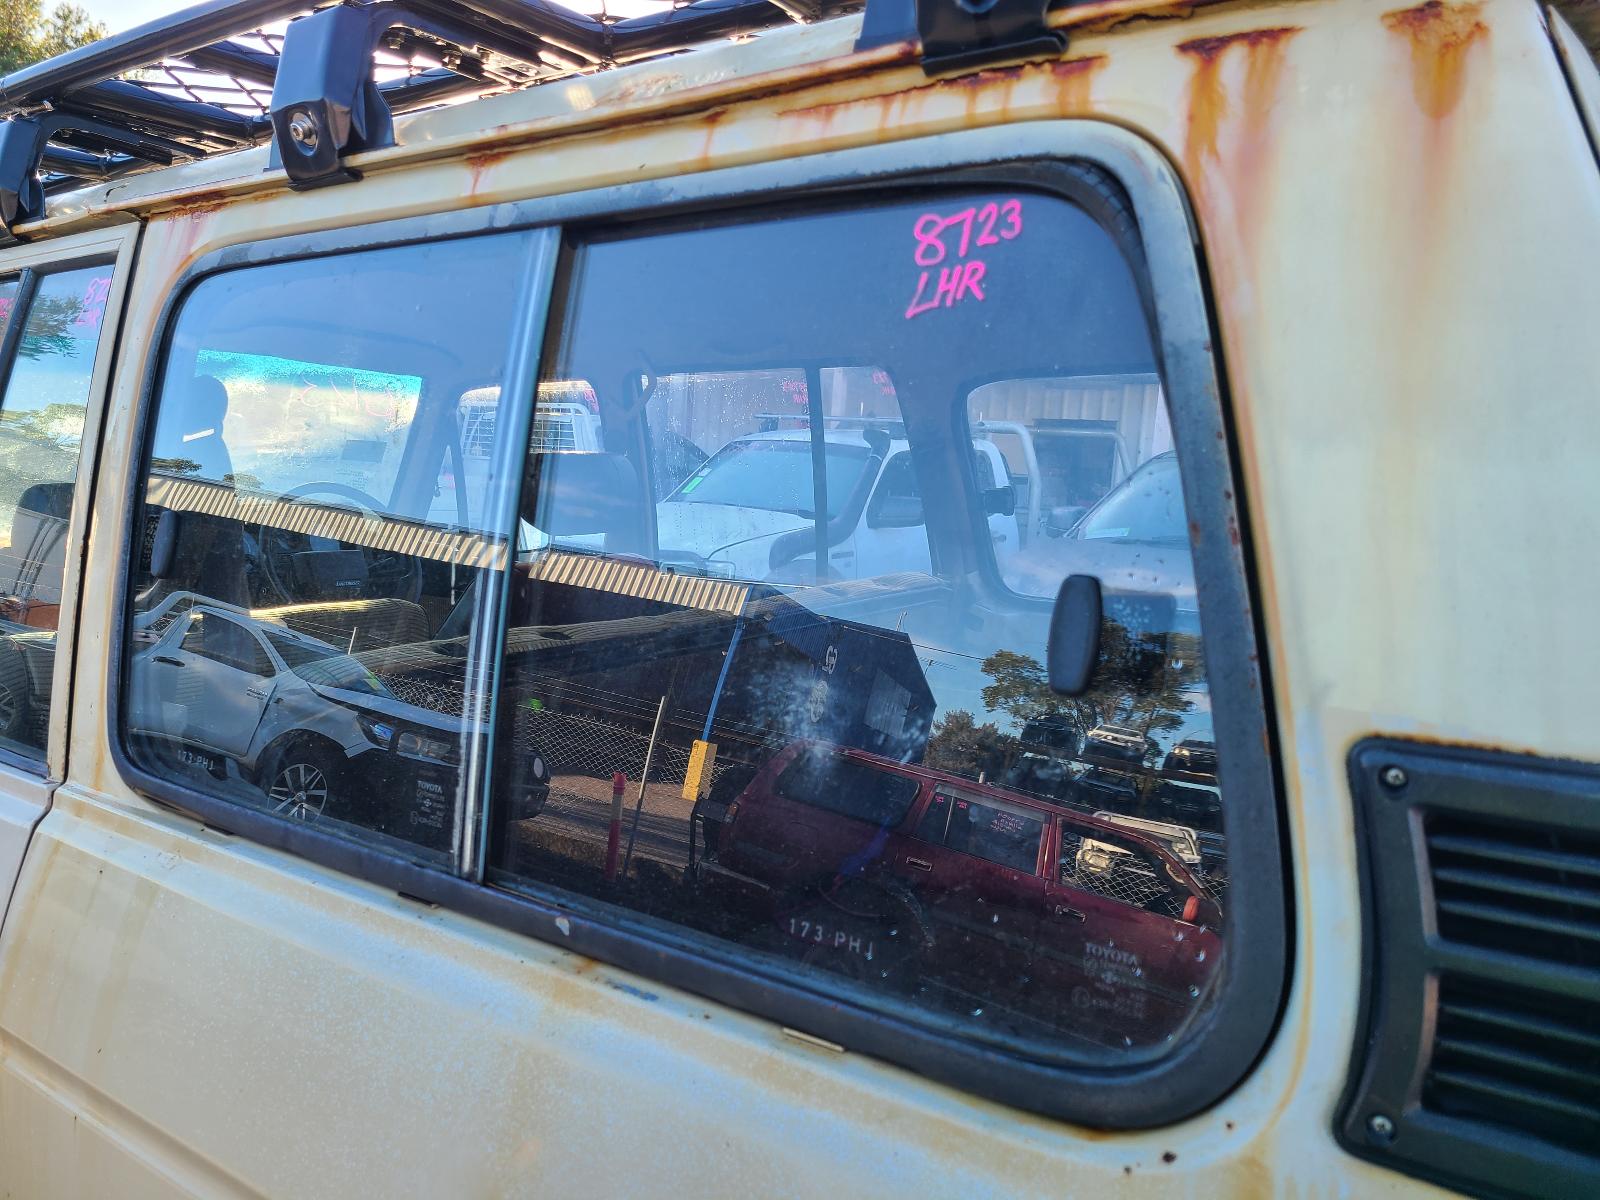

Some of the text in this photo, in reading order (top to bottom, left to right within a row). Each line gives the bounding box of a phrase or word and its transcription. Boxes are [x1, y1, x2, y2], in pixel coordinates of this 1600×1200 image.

[913, 199, 1023, 267] 8723
[904, 260, 986, 320] LHR
[417, 780, 443, 794] TOYOTA
